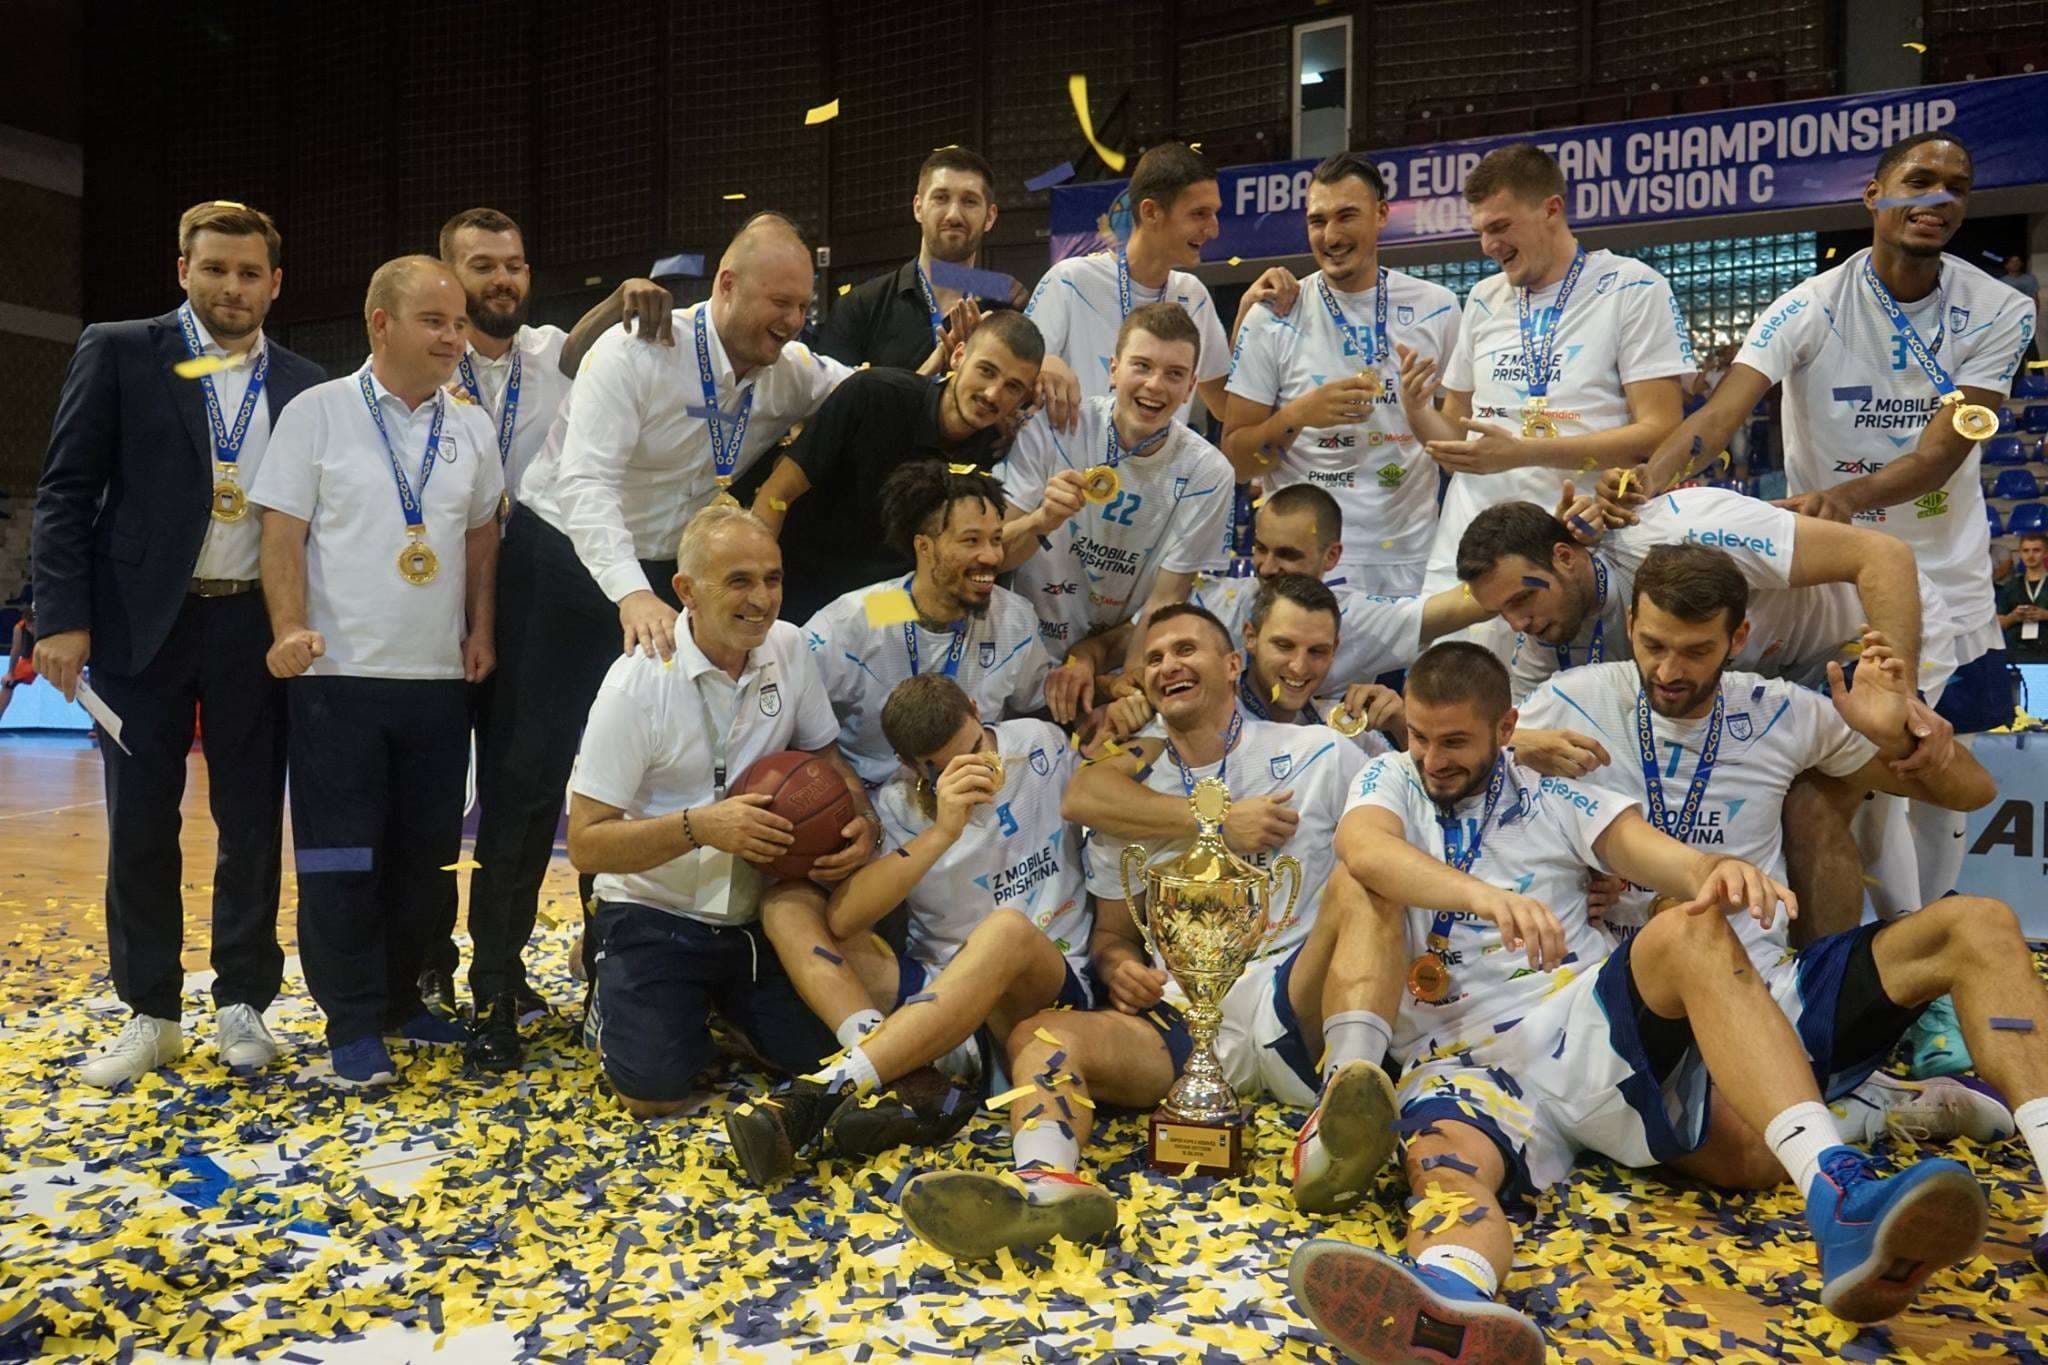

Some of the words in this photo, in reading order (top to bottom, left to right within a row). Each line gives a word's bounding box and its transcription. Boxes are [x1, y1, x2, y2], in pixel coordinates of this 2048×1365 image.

[1235, 170, 1311, 215] FIBA
[1409, 137, 1612, 198] EURAN
[1625, 99, 1957, 176] CHAMPIONSHIP
[1575, 167, 1738, 220] DIVISION
[1748, 165, 1775, 203] C
[1556, 265, 1580, 310] KOSOVO
[1867, 273, 1900, 318] KOSOVO
[1750, 299, 1809, 348] teleset
[697, 327, 712, 382] KOSOVO
[1497, 354, 1509, 367] Z
[1524, 338, 1539, 386] KOSOVO
[1890, 335, 1909, 372] 3
[1908, 338, 1945, 384] KOSOVO
[206, 391, 228, 448] KOSOVO
[229, 401, 252, 450] KOSOVO
[1854, 413, 1934, 429] PRISHTIN
[1860, 399, 1873, 412] Z
[1875, 396, 1940, 412] MOBILE
[725, 416, 745, 465] KOSOVO
[1308, 470, 1355, 482] PRINCE
[1102, 490, 1142, 527] 22
[1086, 538, 1140, 564] MOBILE
[1687, 528, 1777, 557] teleset
[1638, 698, 1654, 762] KOSOVO
[1703, 701, 1723, 763] KOSOVO
[1663, 740, 1684, 778] 7
[1968, 799, 2048, 858] A
[992, 873, 1005, 890] Z
[1005, 846, 1053, 879] MOBILE
